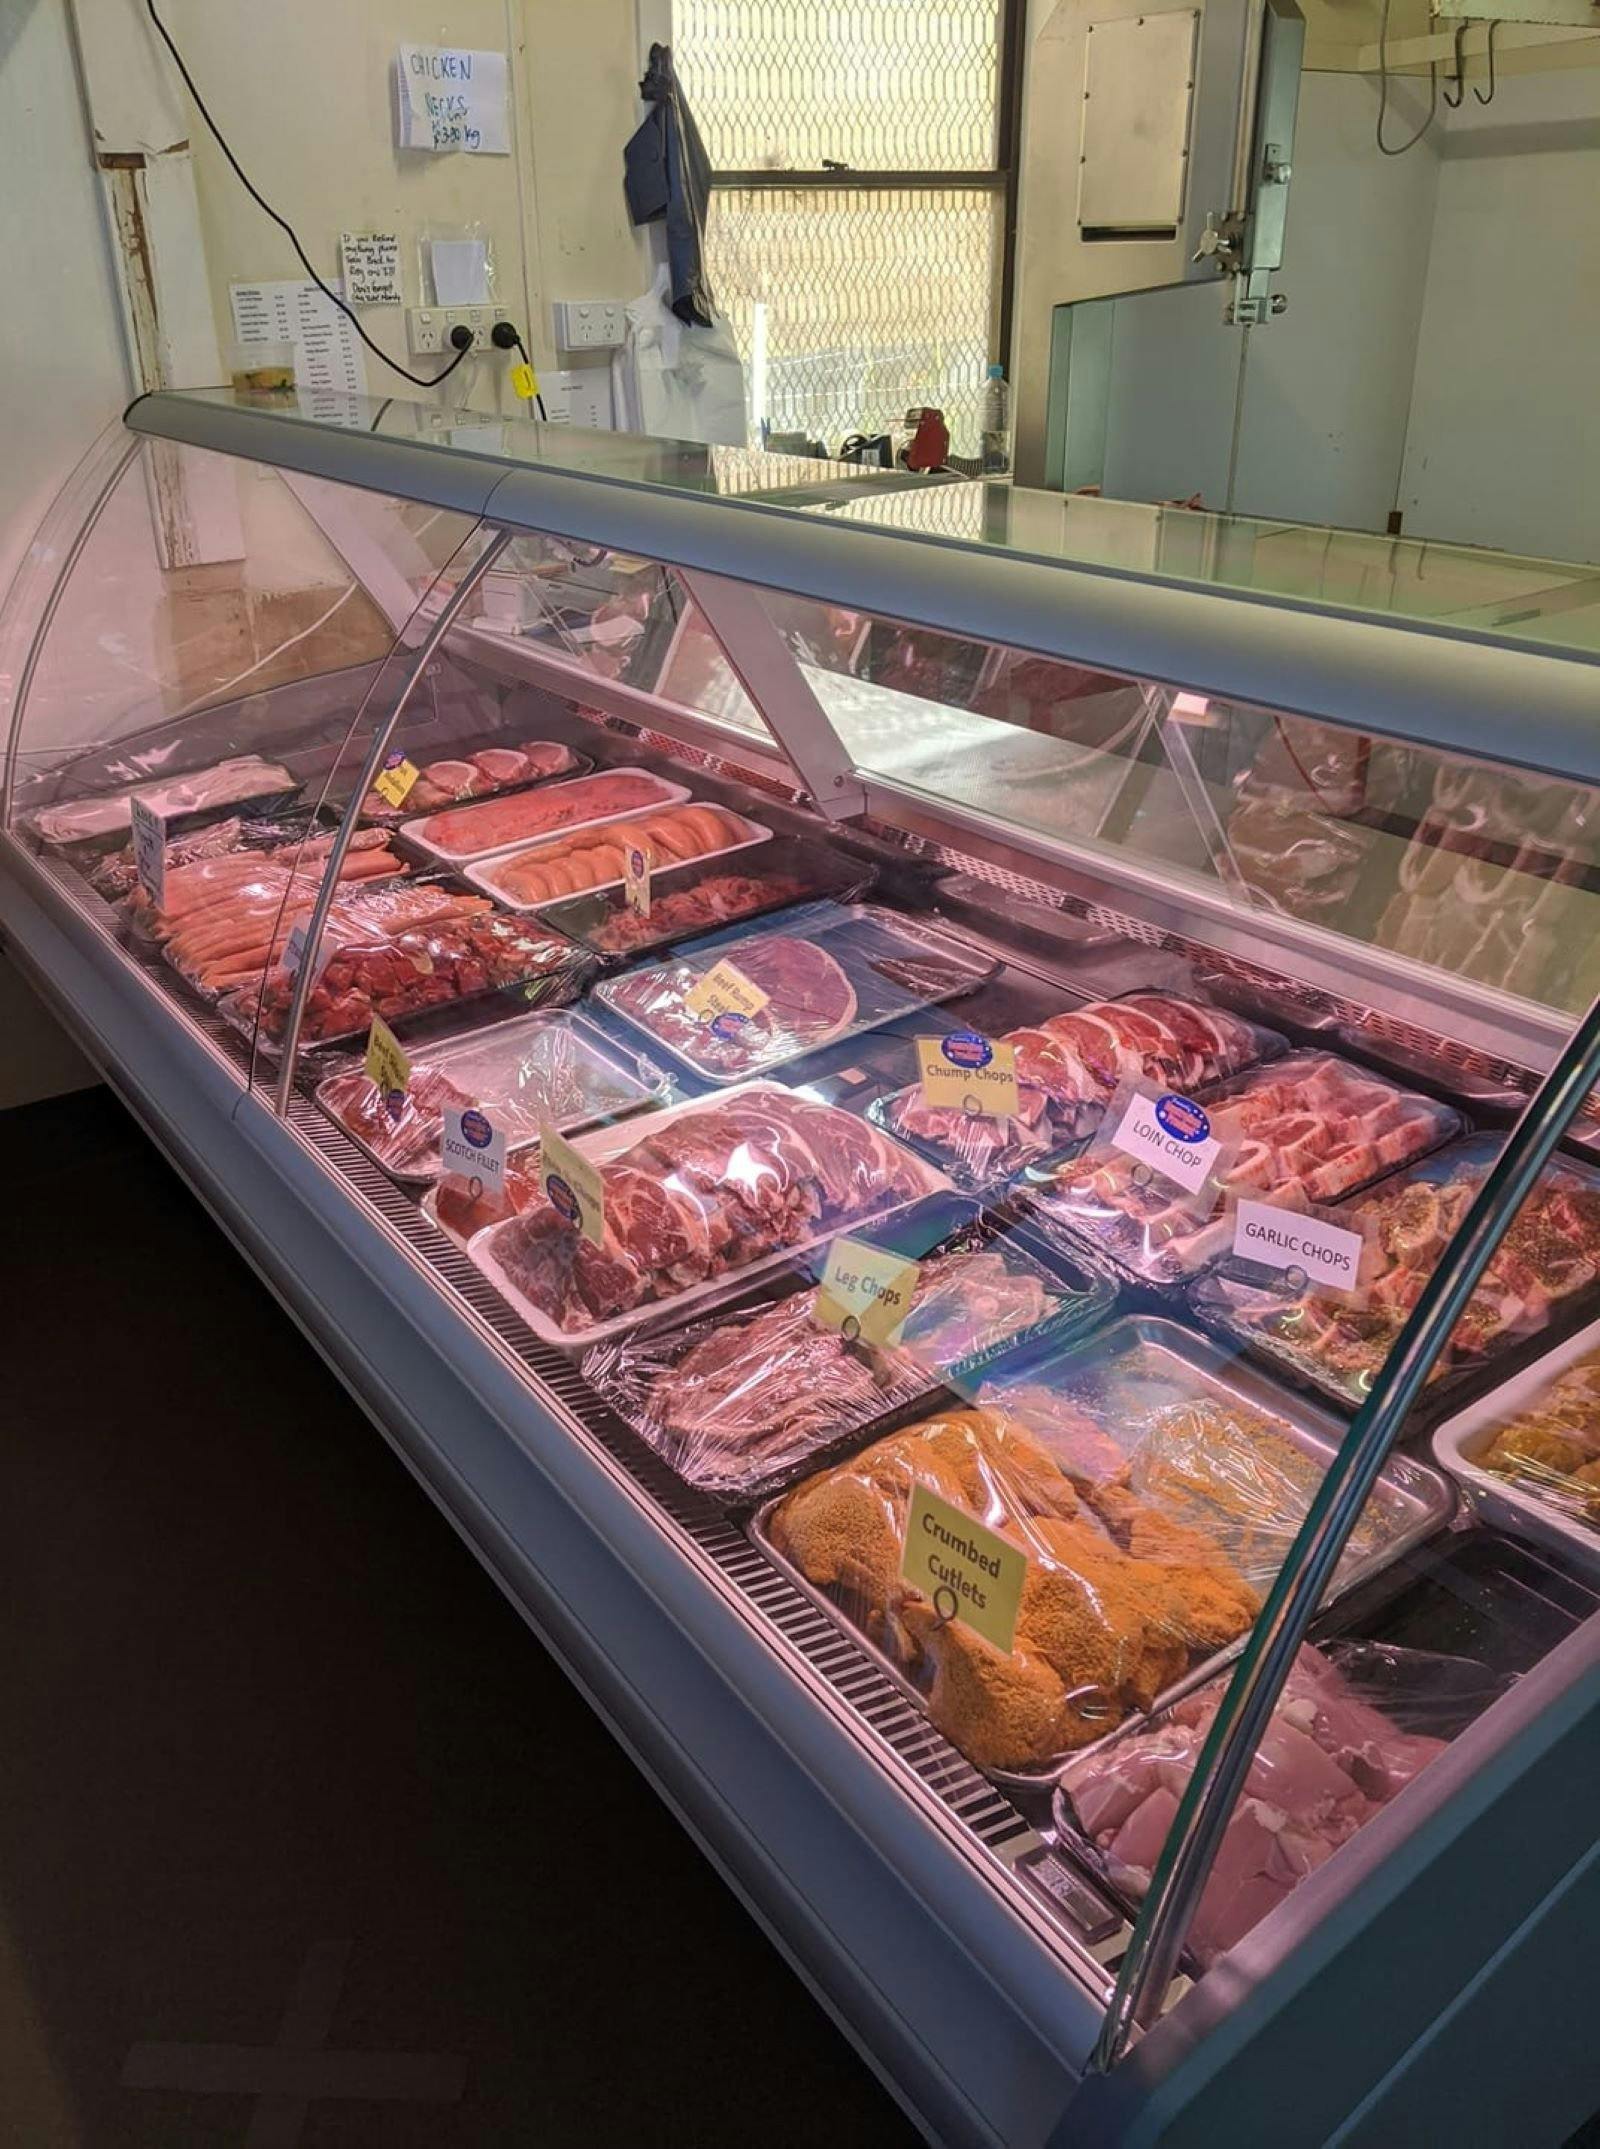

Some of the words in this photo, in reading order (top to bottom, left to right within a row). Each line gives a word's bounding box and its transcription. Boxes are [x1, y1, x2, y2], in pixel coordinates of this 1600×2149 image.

[410, 54, 472, 80] CHICKEN
[926, 1064, 971, 1082] Chump
[975, 1068, 1014, 1085] Chops
[446, 1139, 476, 1162] SCOTCH
[1133, 1120, 1165, 1147] LOIN
[1165, 1140, 1202, 1167] CHOP
[1245, 1222, 1300, 1251] GARLIC
[1302, 1241, 1352, 1271] CHOPS
[835, 1266, 860, 1292] Leg
[861, 1276, 902, 1306] Chops
[922, 1513, 1002, 1579] Crumbed
[927, 1554, 988, 1609] Cutlets
